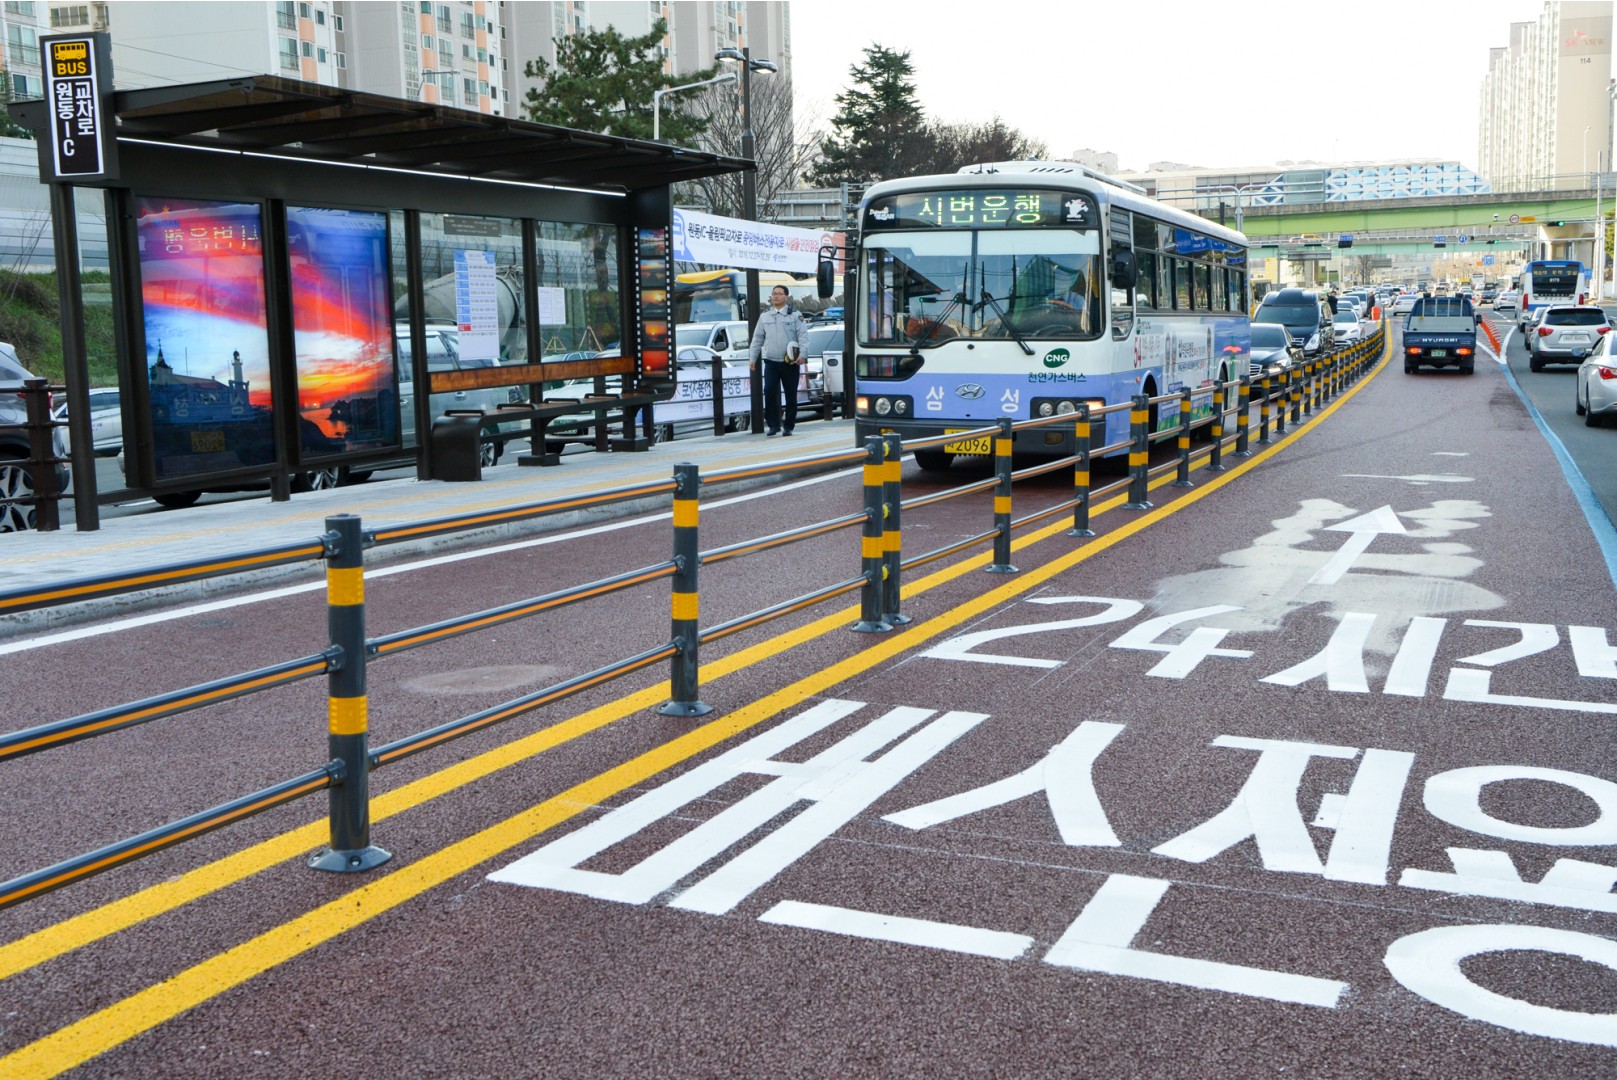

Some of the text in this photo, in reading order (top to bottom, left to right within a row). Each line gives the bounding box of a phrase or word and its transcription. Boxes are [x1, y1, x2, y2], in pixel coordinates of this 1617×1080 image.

[57, 62, 87, 75] BUS
[75, 81, 95, 135] 교차로
[1045, 354, 1068, 363] CNG
[1027, 372, 1087, 383] 천연가스버스
[926, 386, 1020, 413] 삼 성
[918, 596, 1617, 713] 24시간
[486, 698, 1617, 1045] 버스전용
